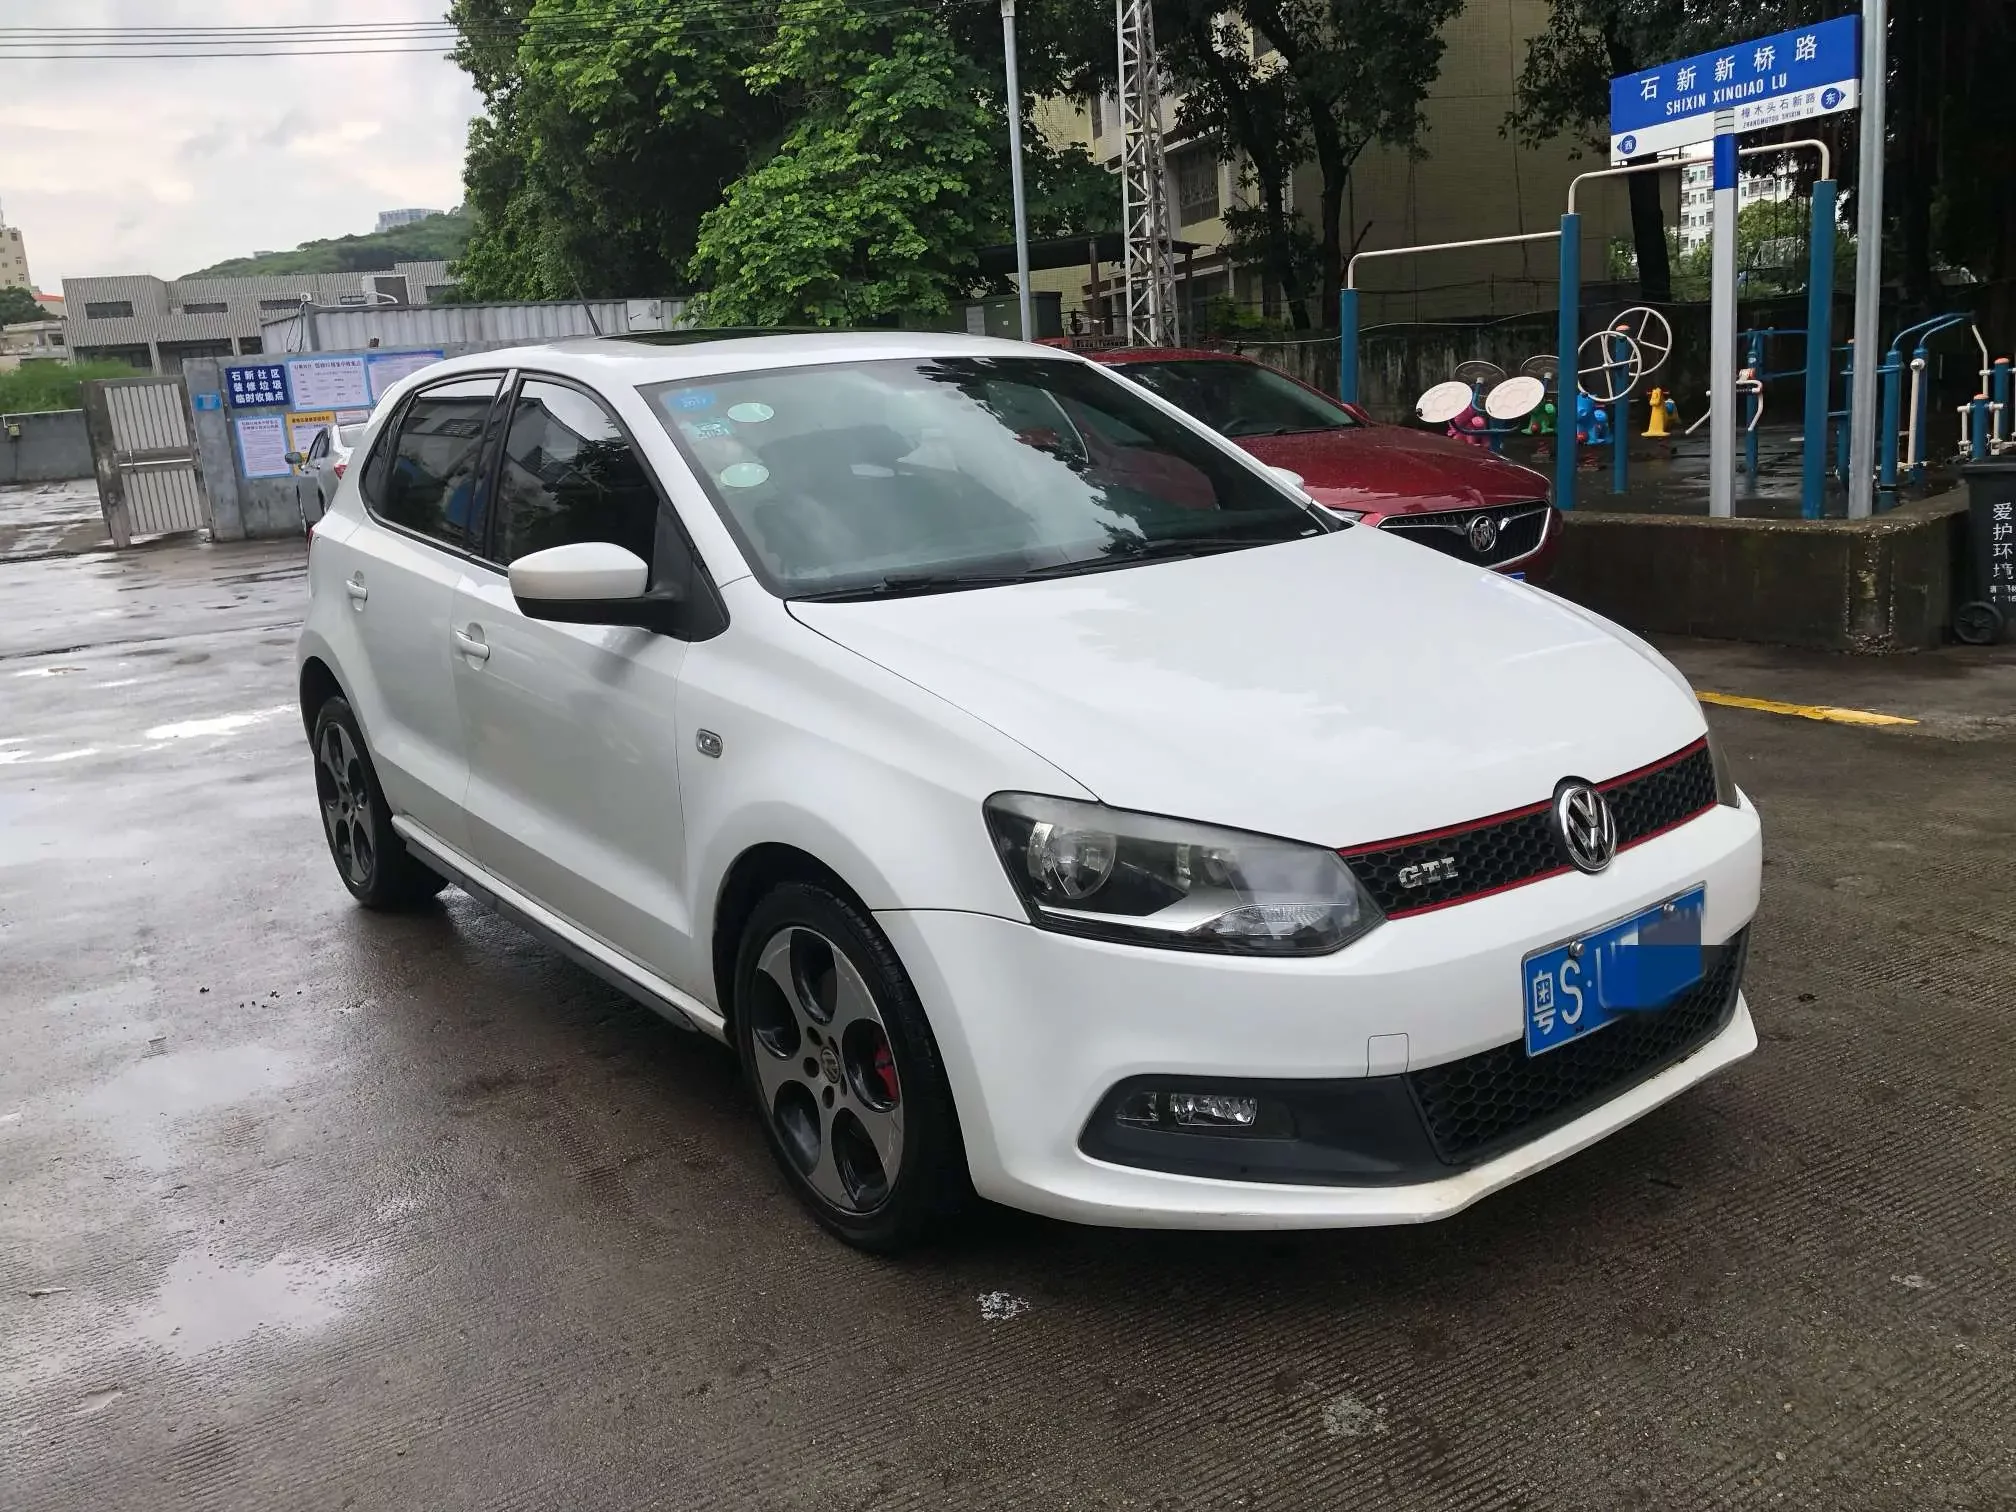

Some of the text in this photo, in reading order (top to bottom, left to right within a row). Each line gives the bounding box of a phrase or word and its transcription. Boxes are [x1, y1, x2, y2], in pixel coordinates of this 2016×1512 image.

[1640, 34, 1818, 101] 石新新桥路
[1666, 73, 1787, 116] SHIXIN XINQIAO LU
[1825, 92, 1835, 105] 东
[231, 369, 281, 381] 石新社区
[233, 380, 283, 392] 装修垃圾
[235, 391, 285, 404] 临时收集点
[1399, 856, 1459, 889] GTI
